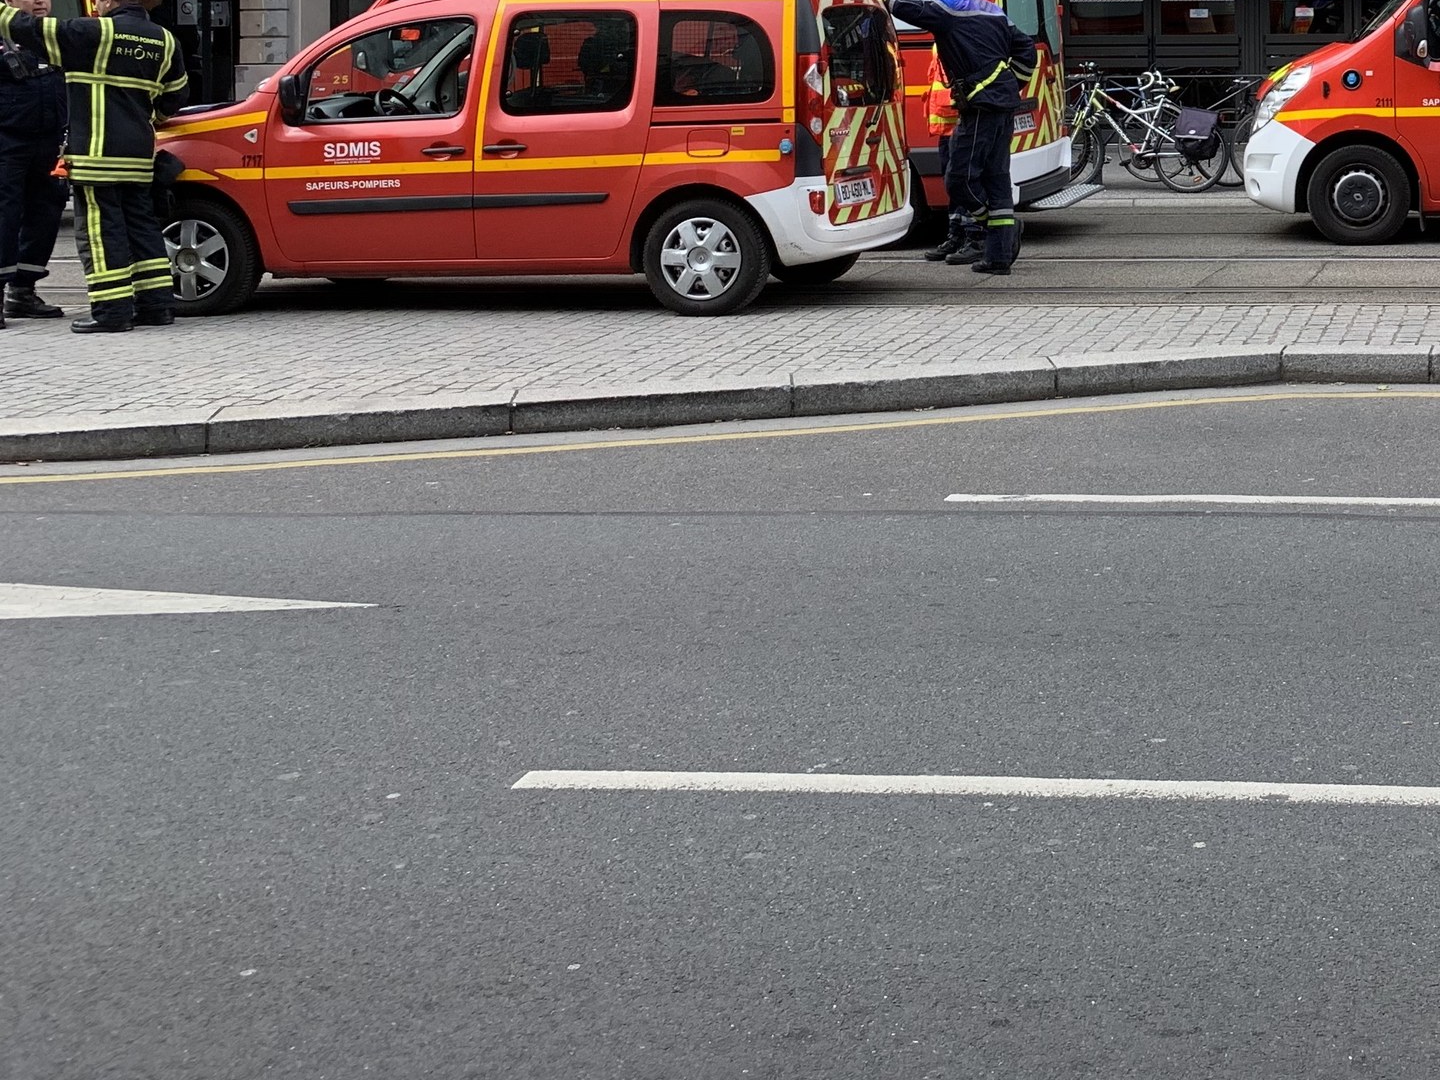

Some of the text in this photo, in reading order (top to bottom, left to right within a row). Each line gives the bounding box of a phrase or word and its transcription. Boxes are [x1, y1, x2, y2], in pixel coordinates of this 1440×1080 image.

[116, 45, 160, 60] RHÔNE
[333, 75, 349, 84] 25
[1376, 98, 1393, 108] 2111
[324, 141, 381, 158] SDMIS
[242, 154, 262, 168] 1717
[306, 179, 400, 190] SAPEURS-POMPIERS
